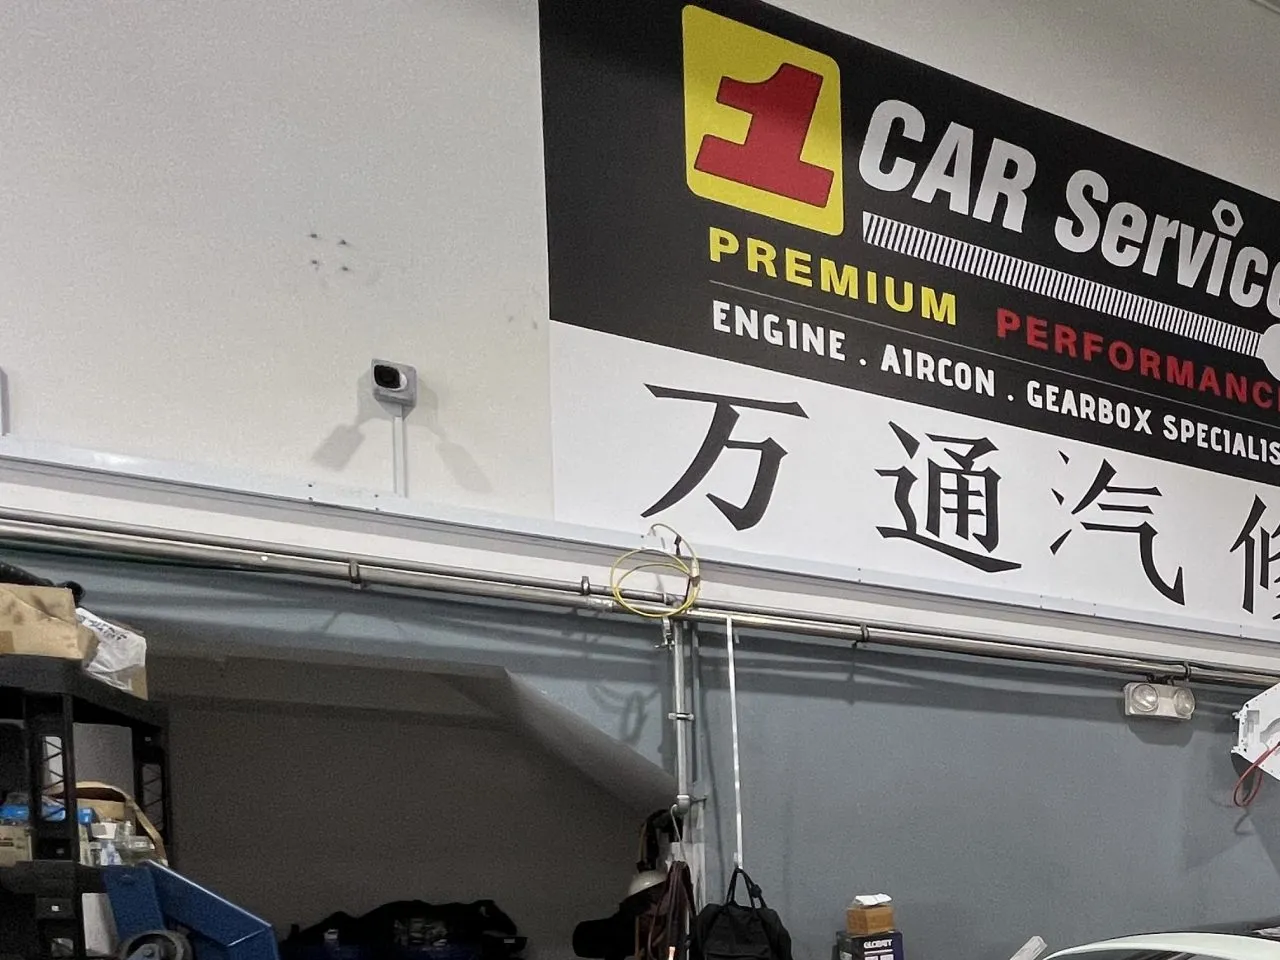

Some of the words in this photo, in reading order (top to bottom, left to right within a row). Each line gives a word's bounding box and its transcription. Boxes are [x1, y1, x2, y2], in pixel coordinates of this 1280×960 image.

[695, 62, 835, 209] 1
[858, 99, 1037, 234] CAR
[709, 226, 957, 326] PREMIUM
[712, 299, 846, 362] ENGINE
[880, 343, 995, 397] AIRCON
[1026, 380, 1153, 435] GEARBOX
